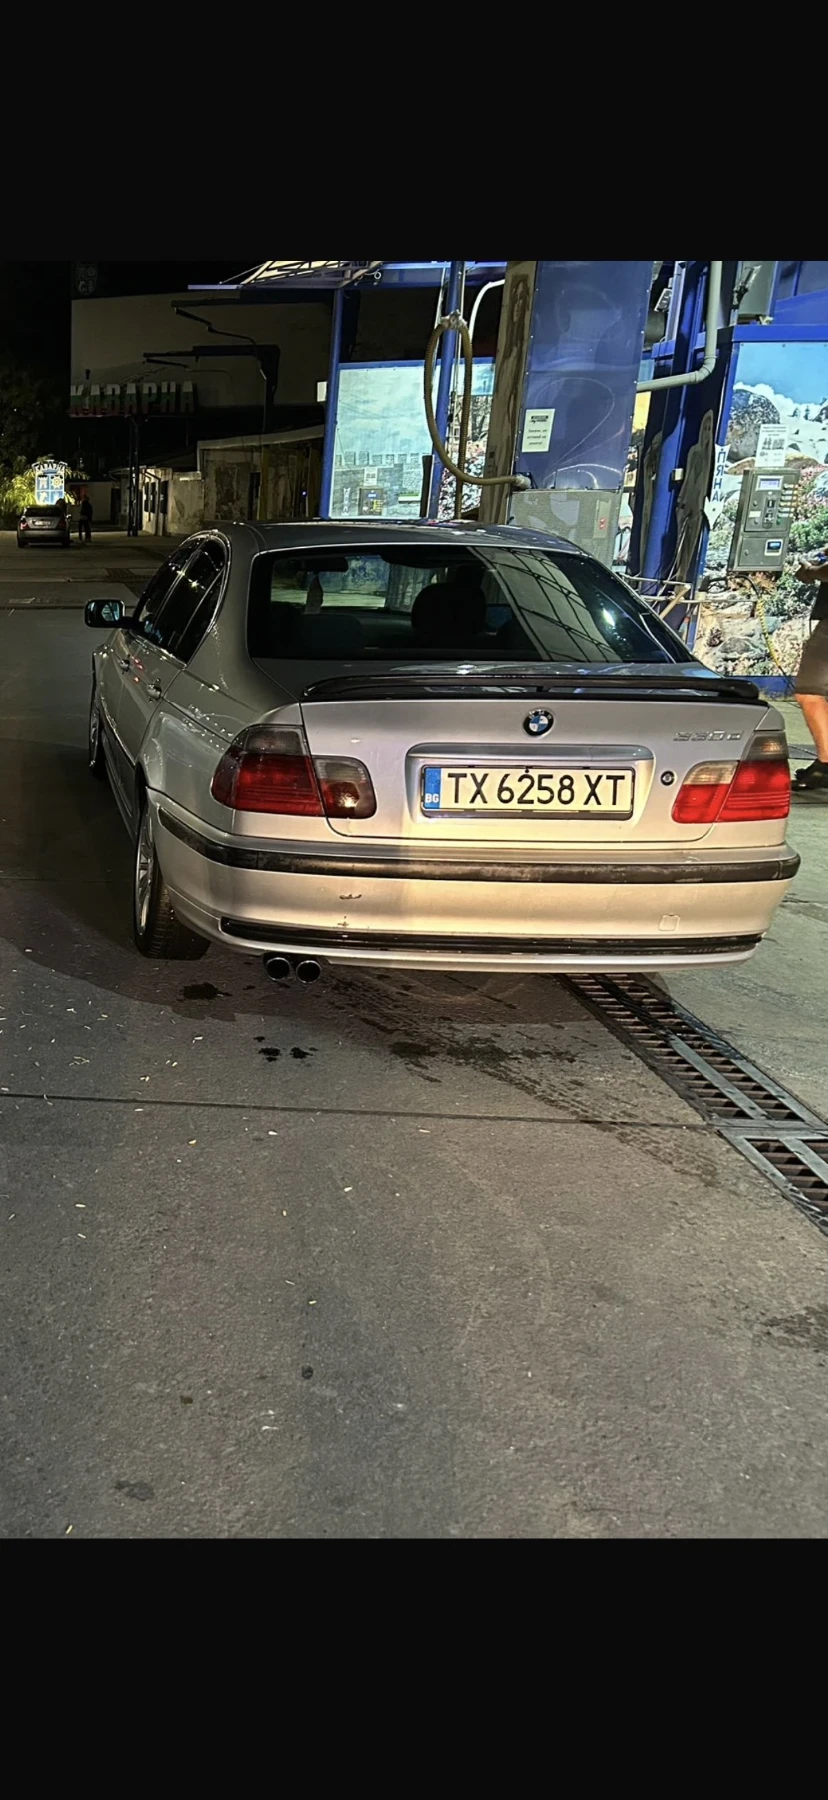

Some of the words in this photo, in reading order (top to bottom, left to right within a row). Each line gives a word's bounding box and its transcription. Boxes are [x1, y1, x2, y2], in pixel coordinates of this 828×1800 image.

[70, 380, 195, 415] КАВАРНА
[712, 452, 726, 502] ПЯНА
[424, 793, 439, 803] BG
[447, 773, 489, 804] TX
[497, 774, 575, 805] 6258
[583, 774, 625, 806] XT
